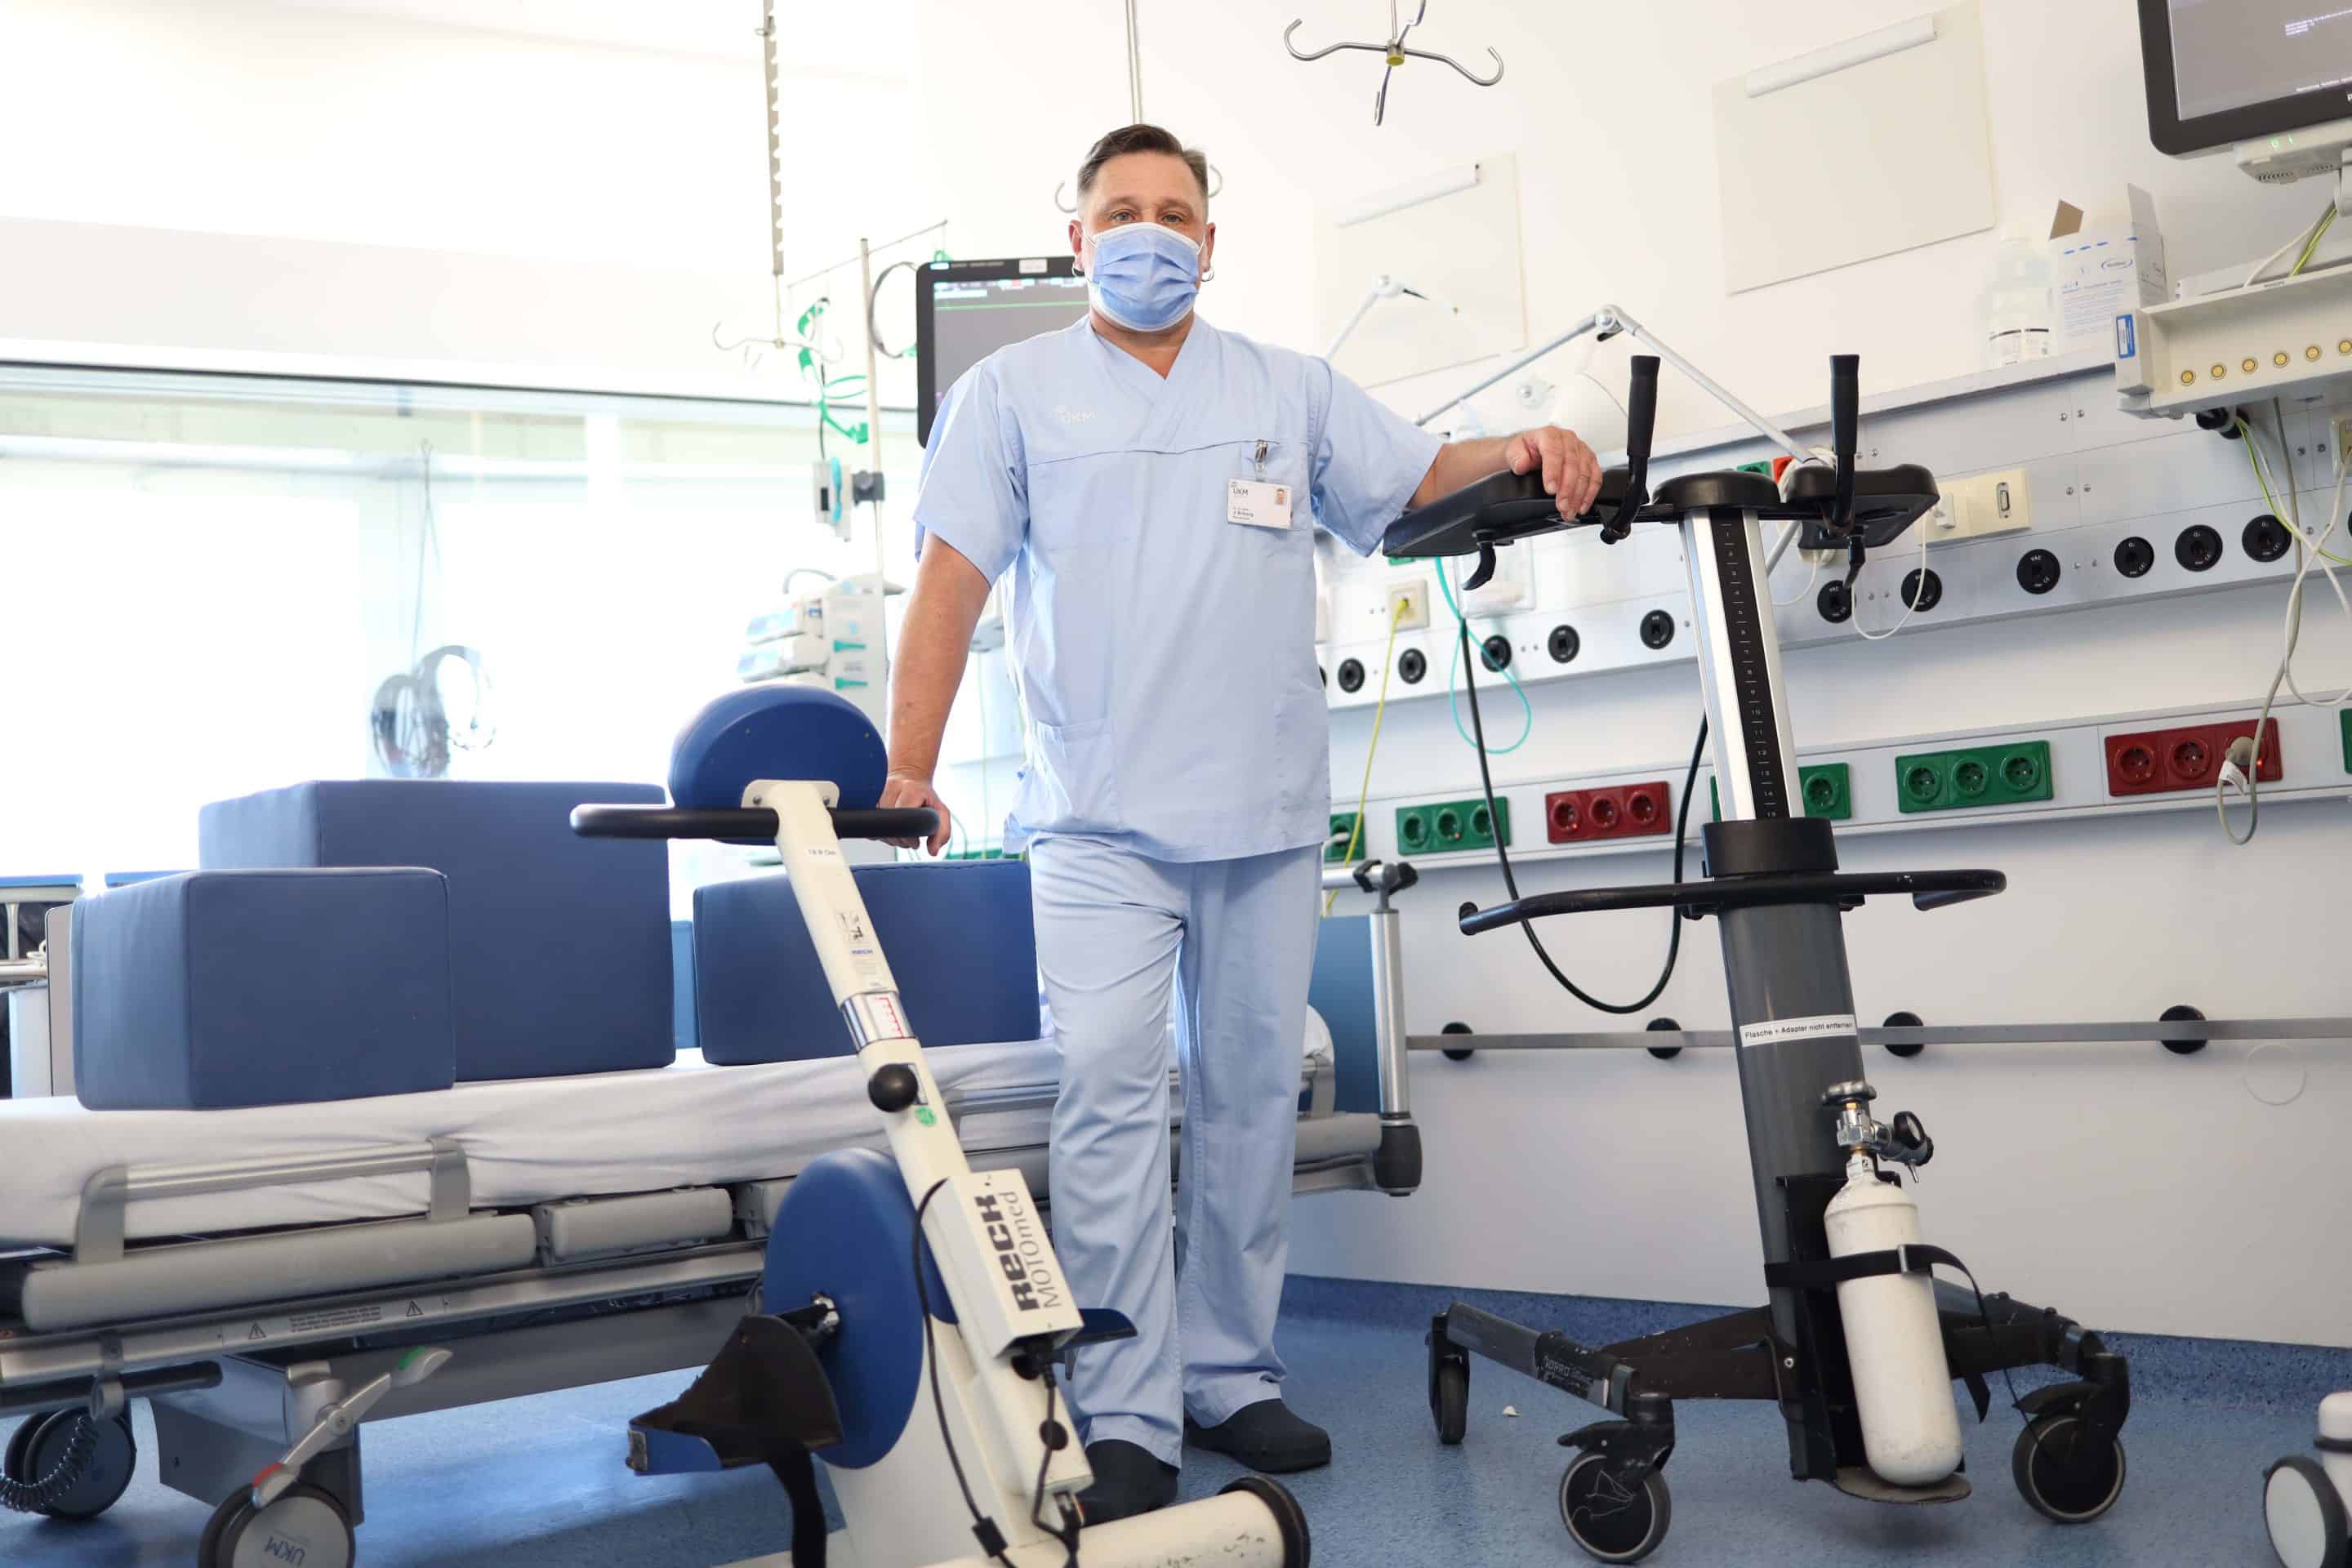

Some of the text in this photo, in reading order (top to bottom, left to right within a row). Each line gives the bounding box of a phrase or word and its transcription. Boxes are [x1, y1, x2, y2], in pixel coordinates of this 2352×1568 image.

[1232, 488, 1249, 496] UKM
[1744, 1030, 1773, 1040] Flasche
[1781, 1025, 1807, 1034] Adapter
[1809, 1023, 1825, 1032] nicht
[996, 1191, 1062, 1309] MOTOmed
[264, 1535, 306, 1567] UKM
